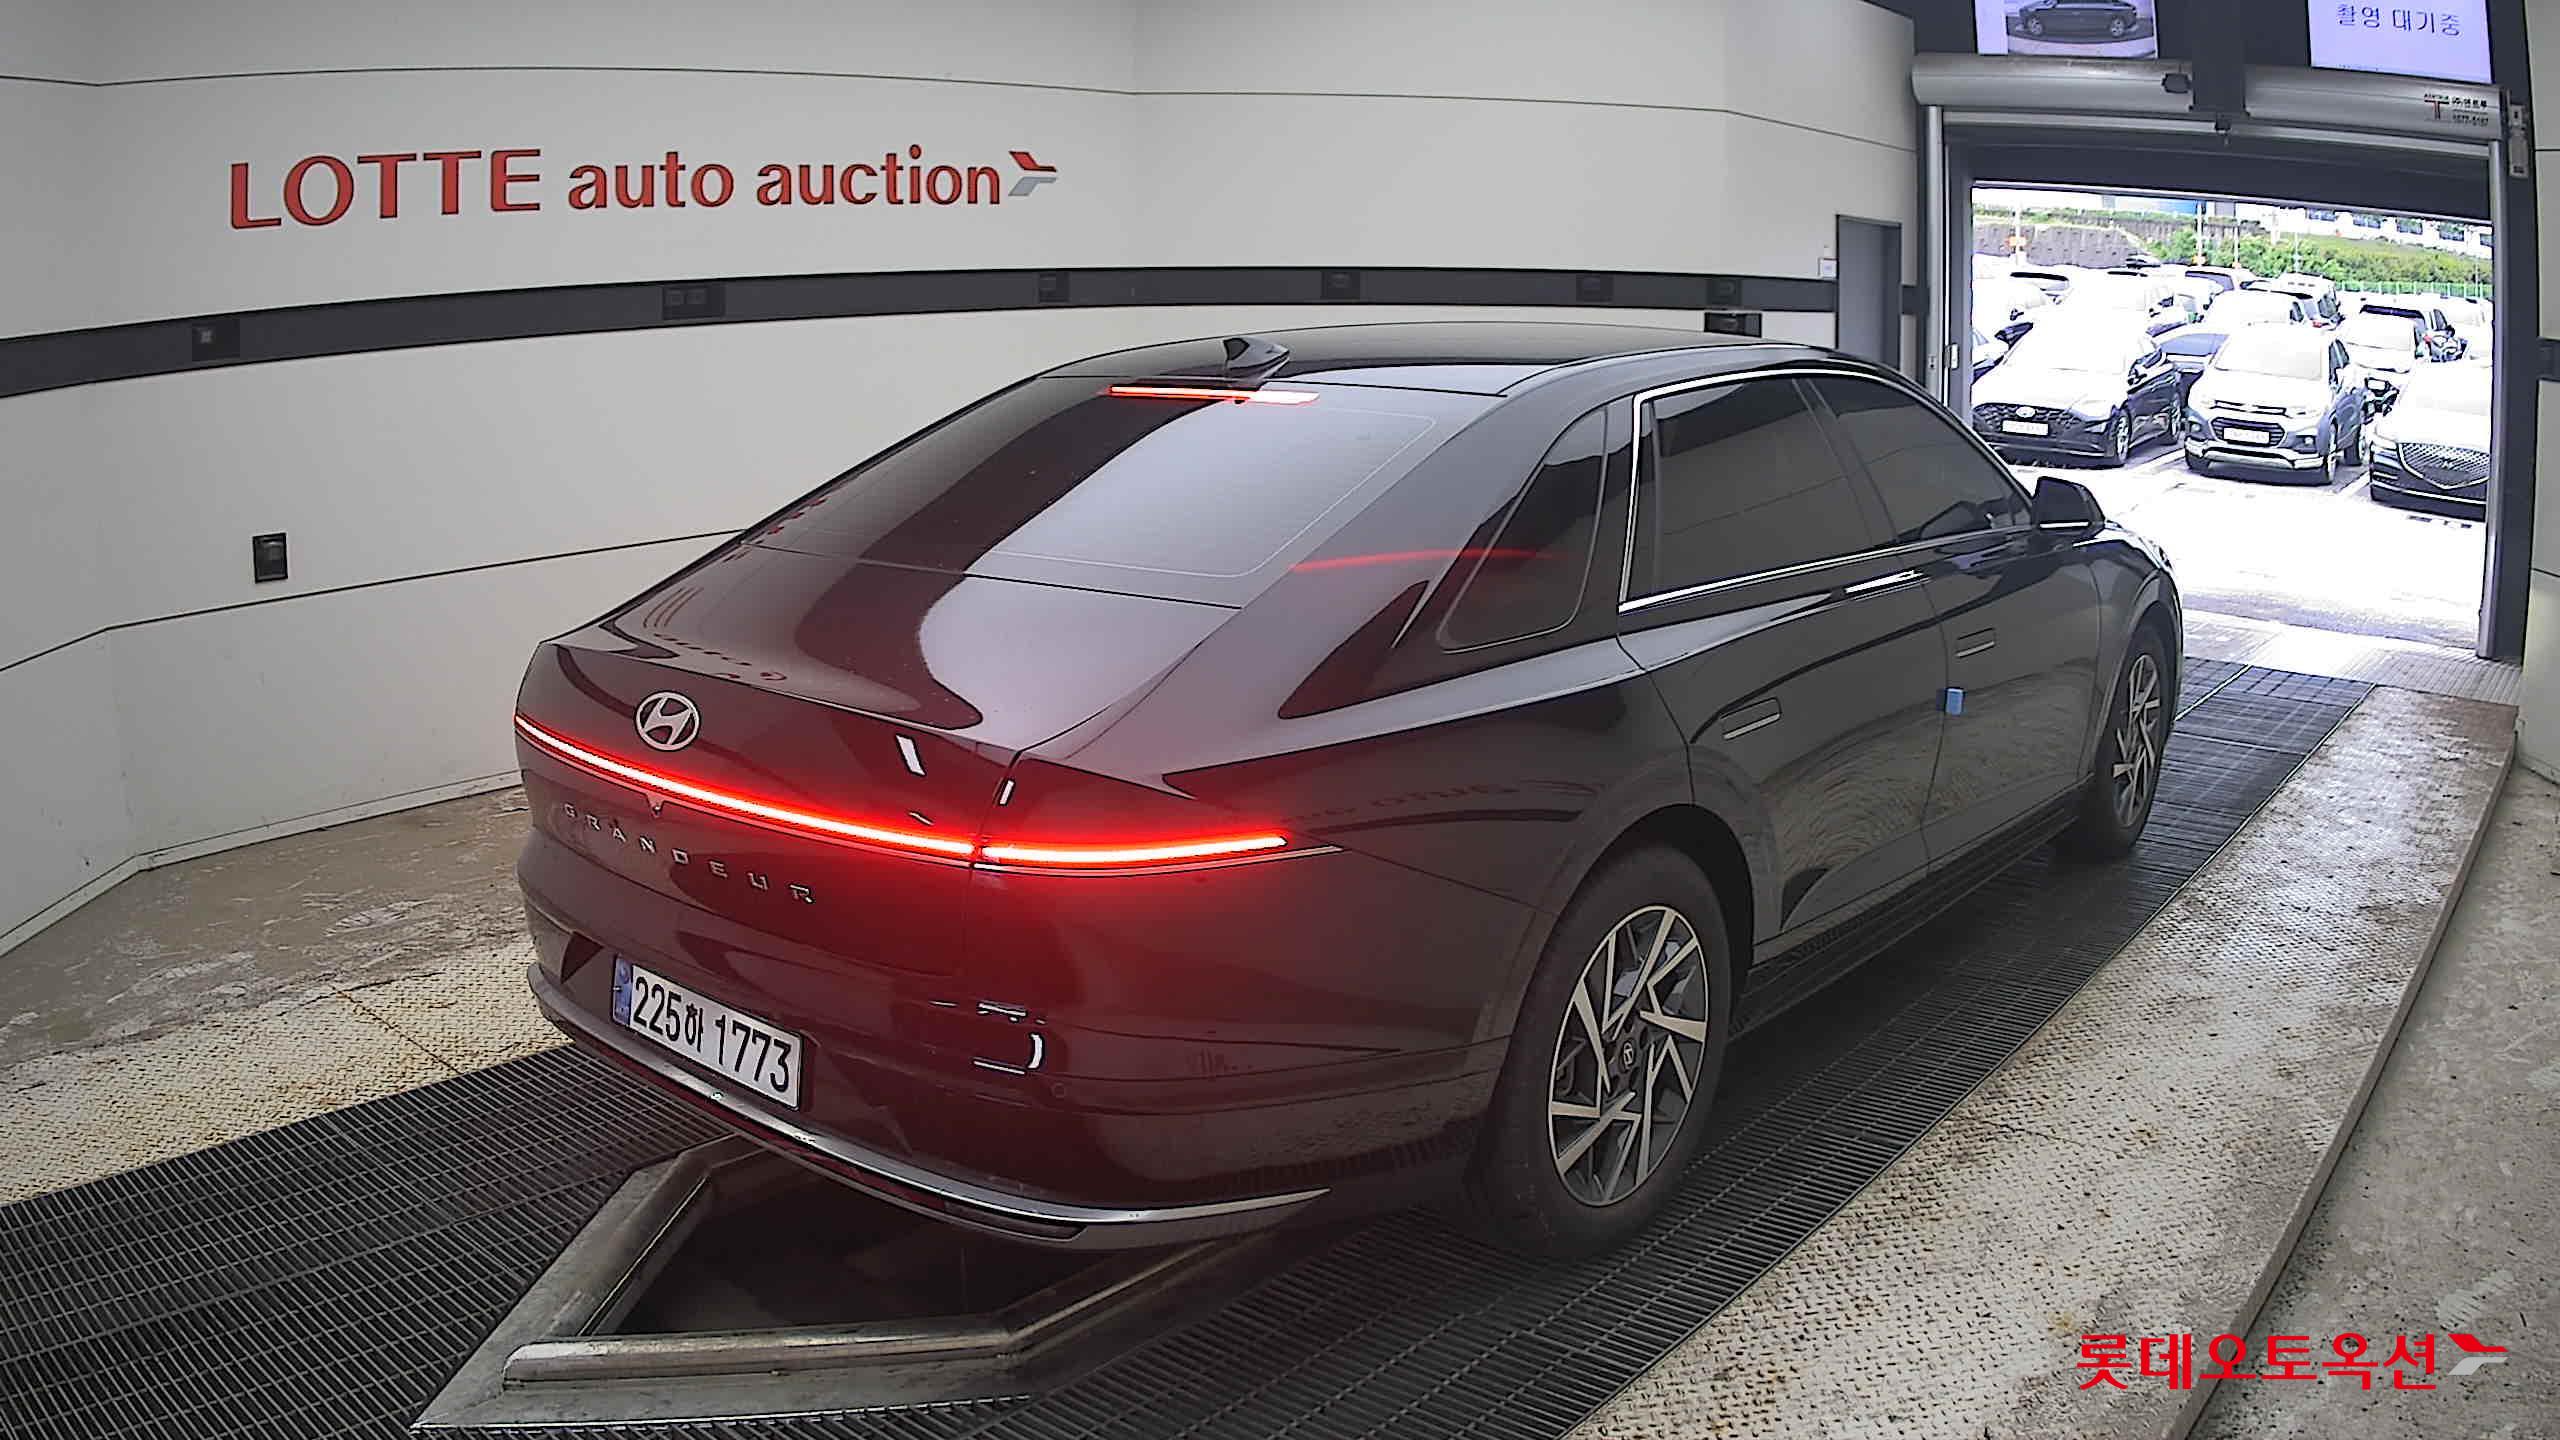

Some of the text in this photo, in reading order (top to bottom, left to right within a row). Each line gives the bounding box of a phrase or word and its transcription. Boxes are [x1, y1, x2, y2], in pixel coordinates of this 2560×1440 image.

[2338, 5, 2460, 36] 촬영 대기중
[230, 144, 1003, 229] LOTTE auto auction
[564, 803, 815, 904] GRANDEUR
[634, 977, 792, 1093] 225하 1773
